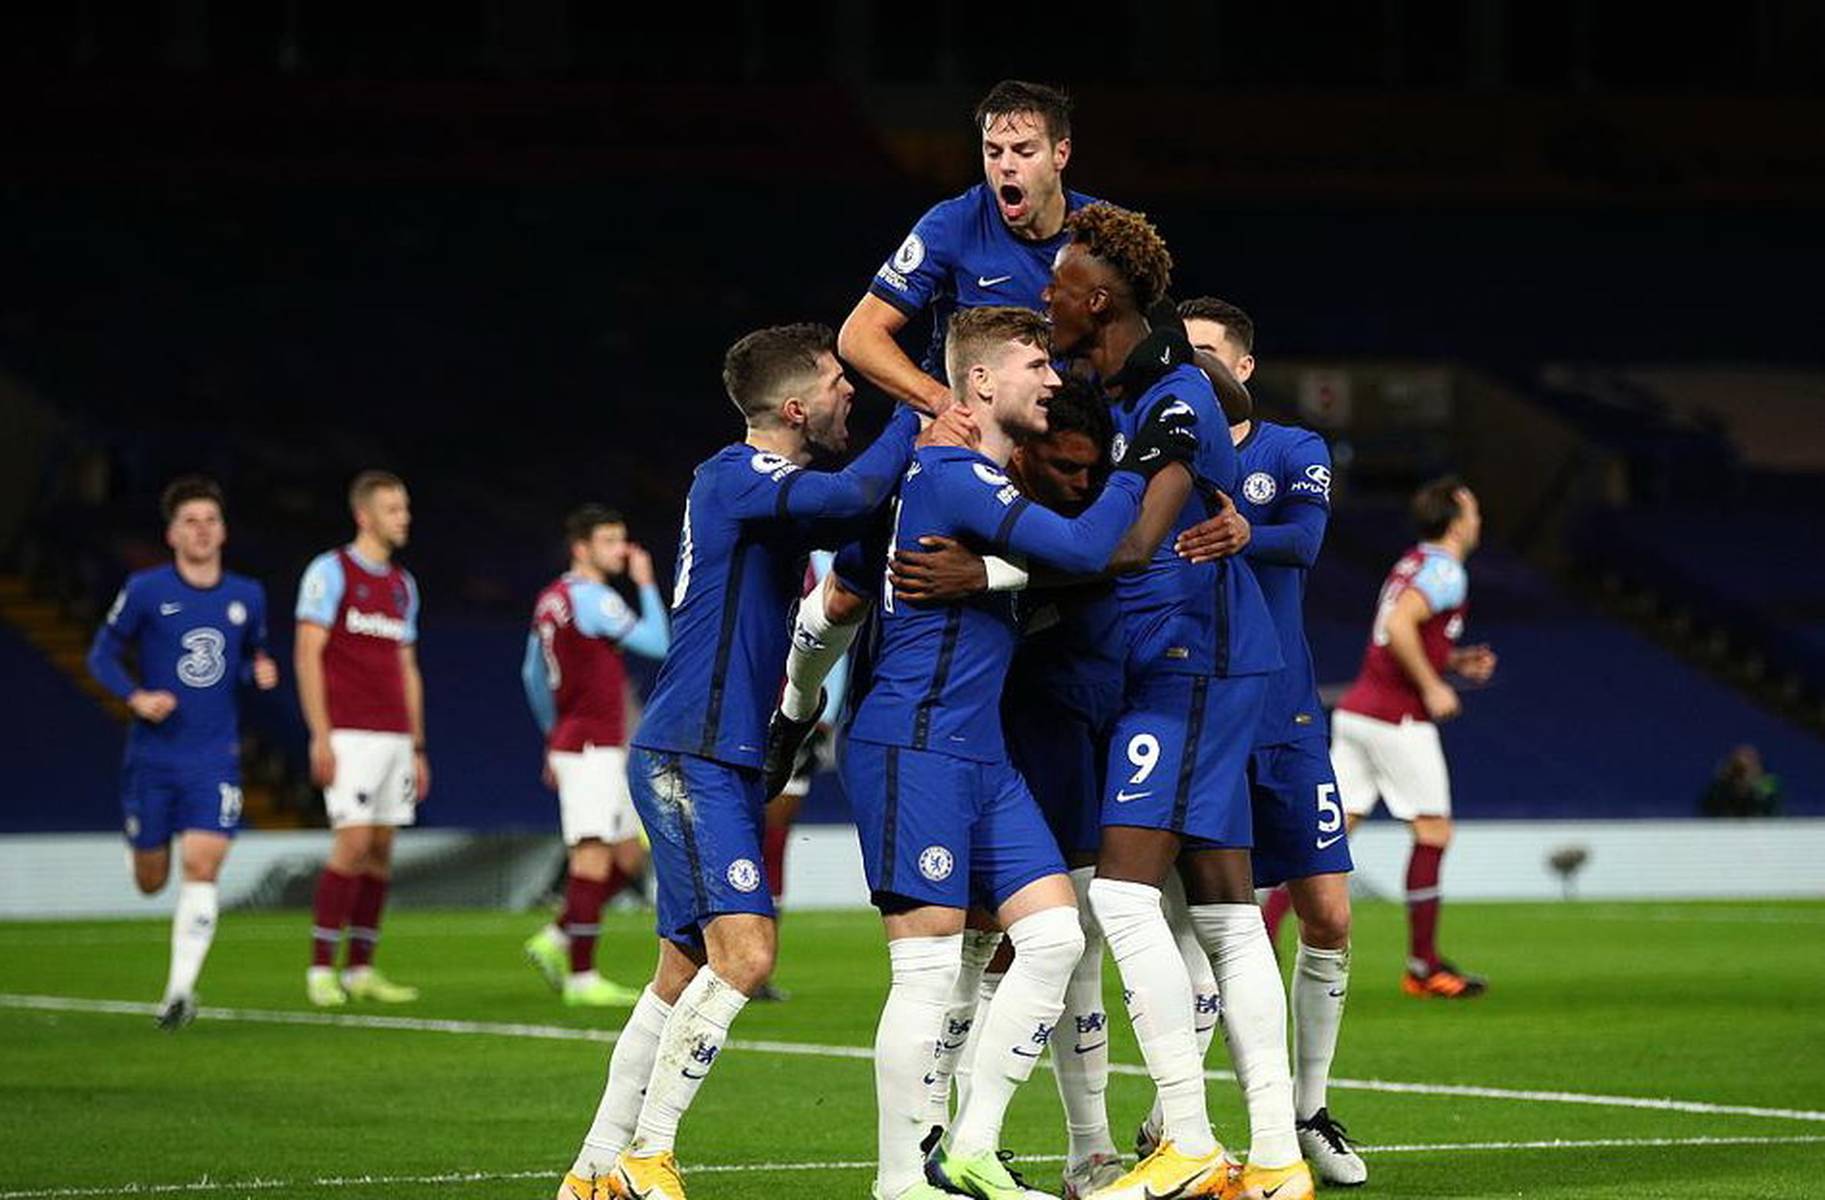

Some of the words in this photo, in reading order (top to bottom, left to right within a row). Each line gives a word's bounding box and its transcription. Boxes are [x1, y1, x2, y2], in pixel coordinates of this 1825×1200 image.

[177, 627, 226, 688] 3
[1127, 733, 1161, 784] 9
[1317, 783, 1341, 833] 5
